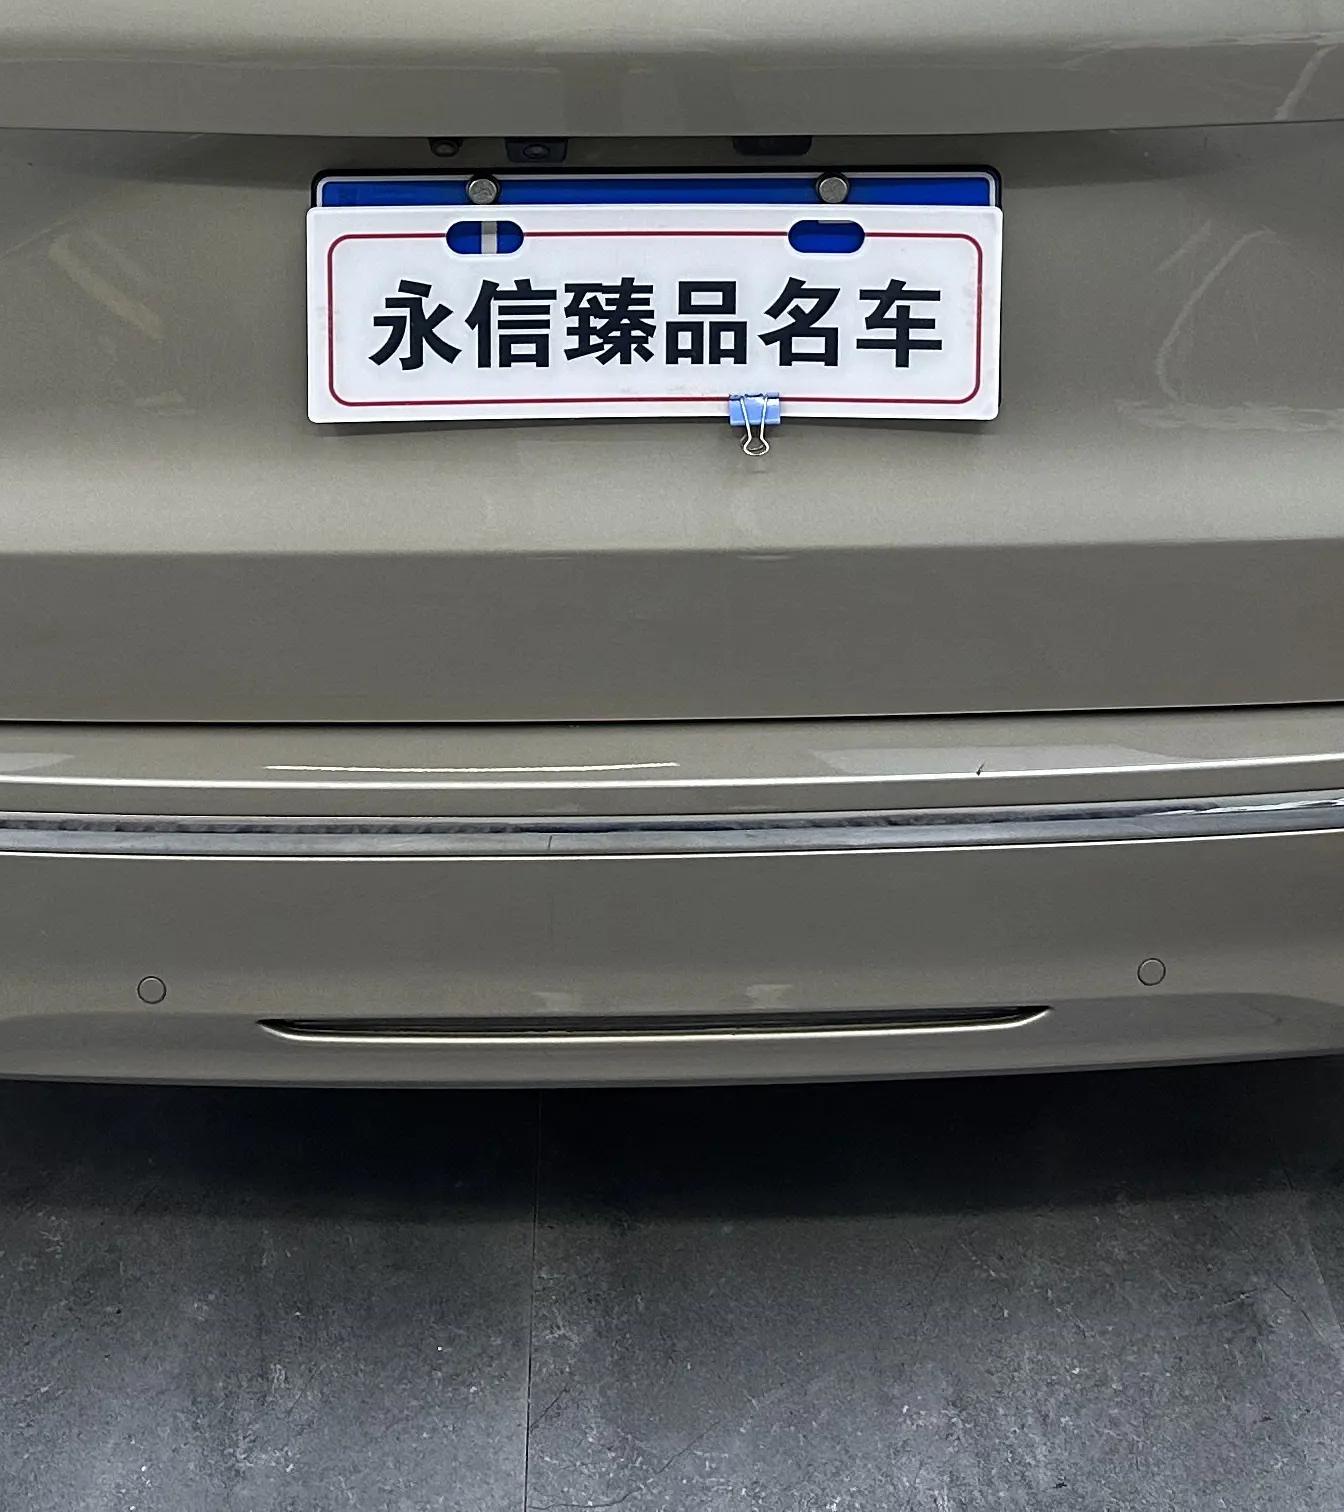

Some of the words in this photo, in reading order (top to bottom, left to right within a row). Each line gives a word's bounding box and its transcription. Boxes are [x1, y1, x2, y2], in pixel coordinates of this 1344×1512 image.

[368, 276, 944, 370] 永信臻品名车
